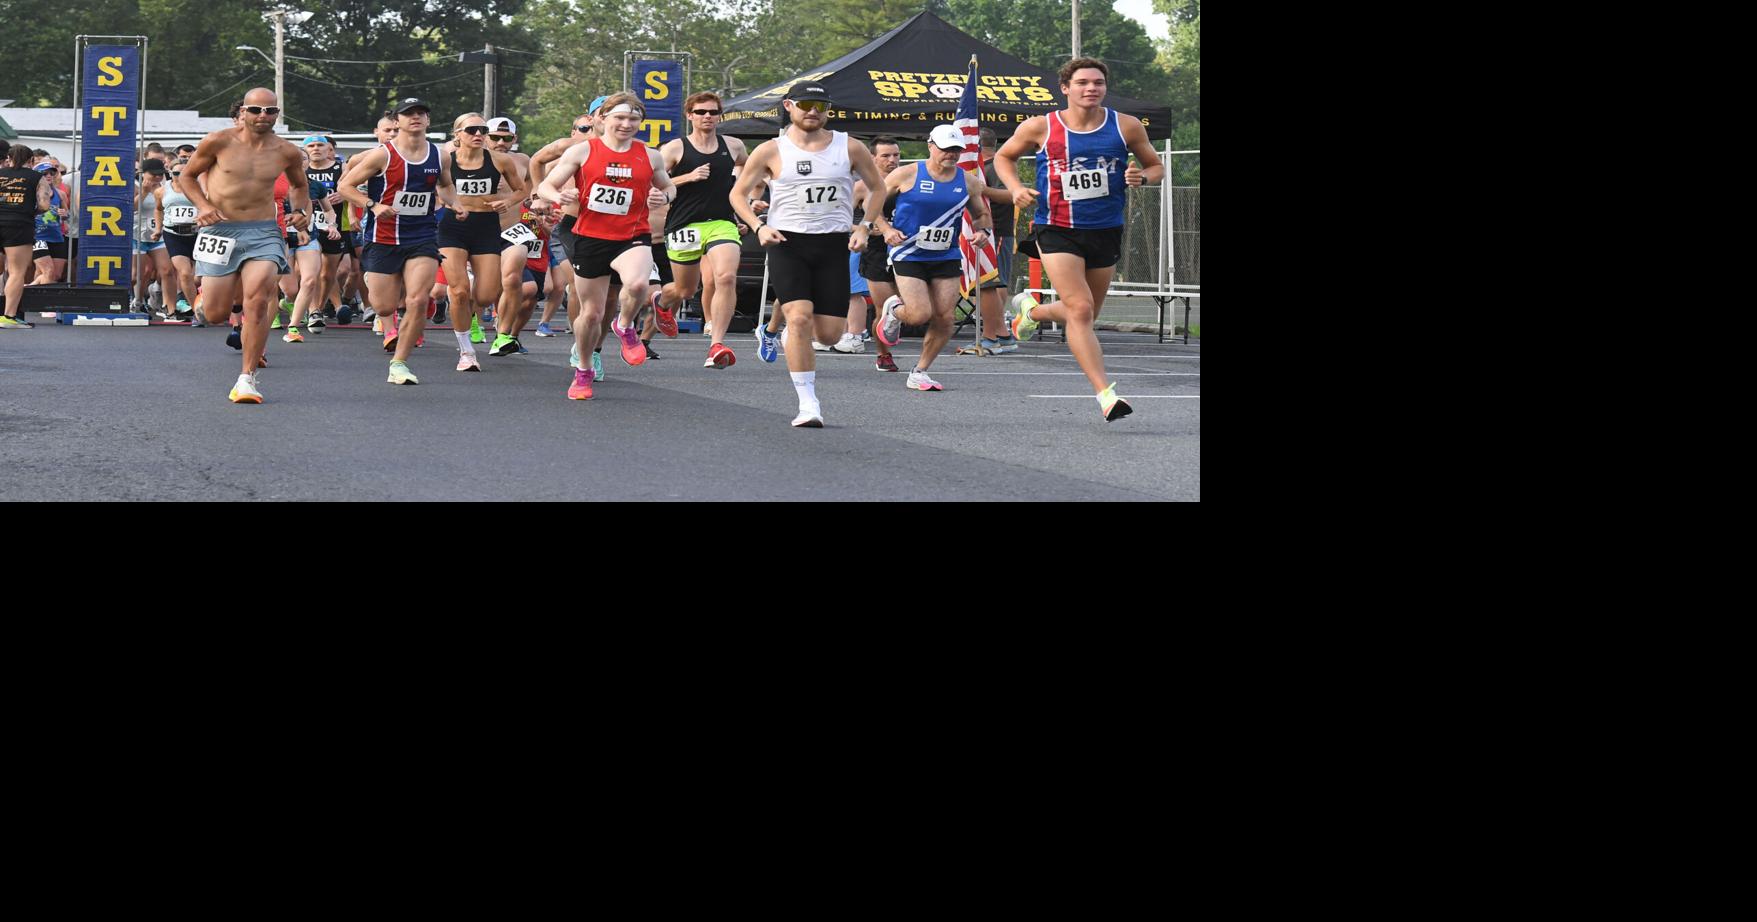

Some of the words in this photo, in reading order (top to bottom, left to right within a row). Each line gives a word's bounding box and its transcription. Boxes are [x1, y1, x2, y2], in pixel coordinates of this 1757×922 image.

[981, 76, 1042, 87] CITY
[854, 111, 911, 121] TIMING
[918, 112, 927, 121] &
[935, 112, 1008, 123] RUING
[86, 56, 127, 286] START
[308, 173, 334, 182] RUN
[461, 181, 487, 194] 433
[1069, 172, 1102, 190] 469
[399, 194, 427, 208] 409
[594, 187, 627, 206] 236
[805, 185, 837, 204] 172
[175, 208, 194, 218] 175
[505, 225, 529, 239] 542
[671, 230, 695, 243] 415
[923, 229, 950, 243] 199
[198, 236, 229, 255] 535
